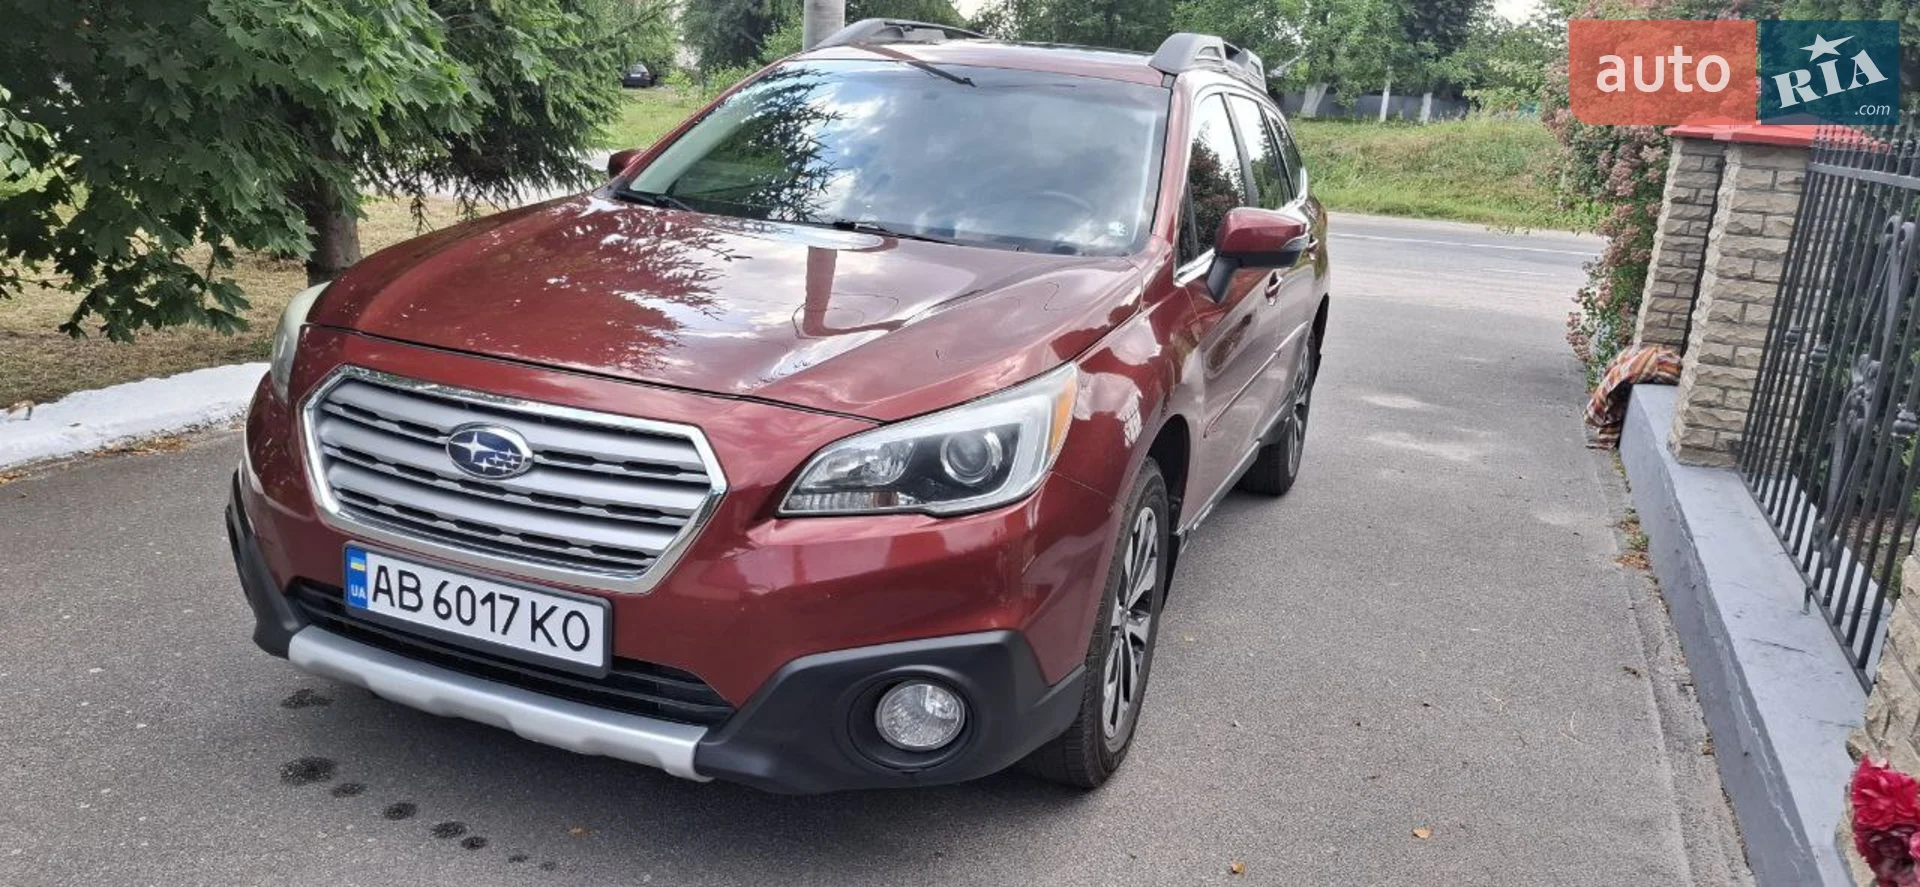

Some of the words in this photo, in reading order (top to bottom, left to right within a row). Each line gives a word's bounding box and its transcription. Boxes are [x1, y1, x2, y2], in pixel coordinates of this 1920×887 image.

[351, 584, 366, 599] UA
[372, 565, 423, 612] AB
[433, 580, 520, 635] 6017
[530, 601, 590, 651] KO
